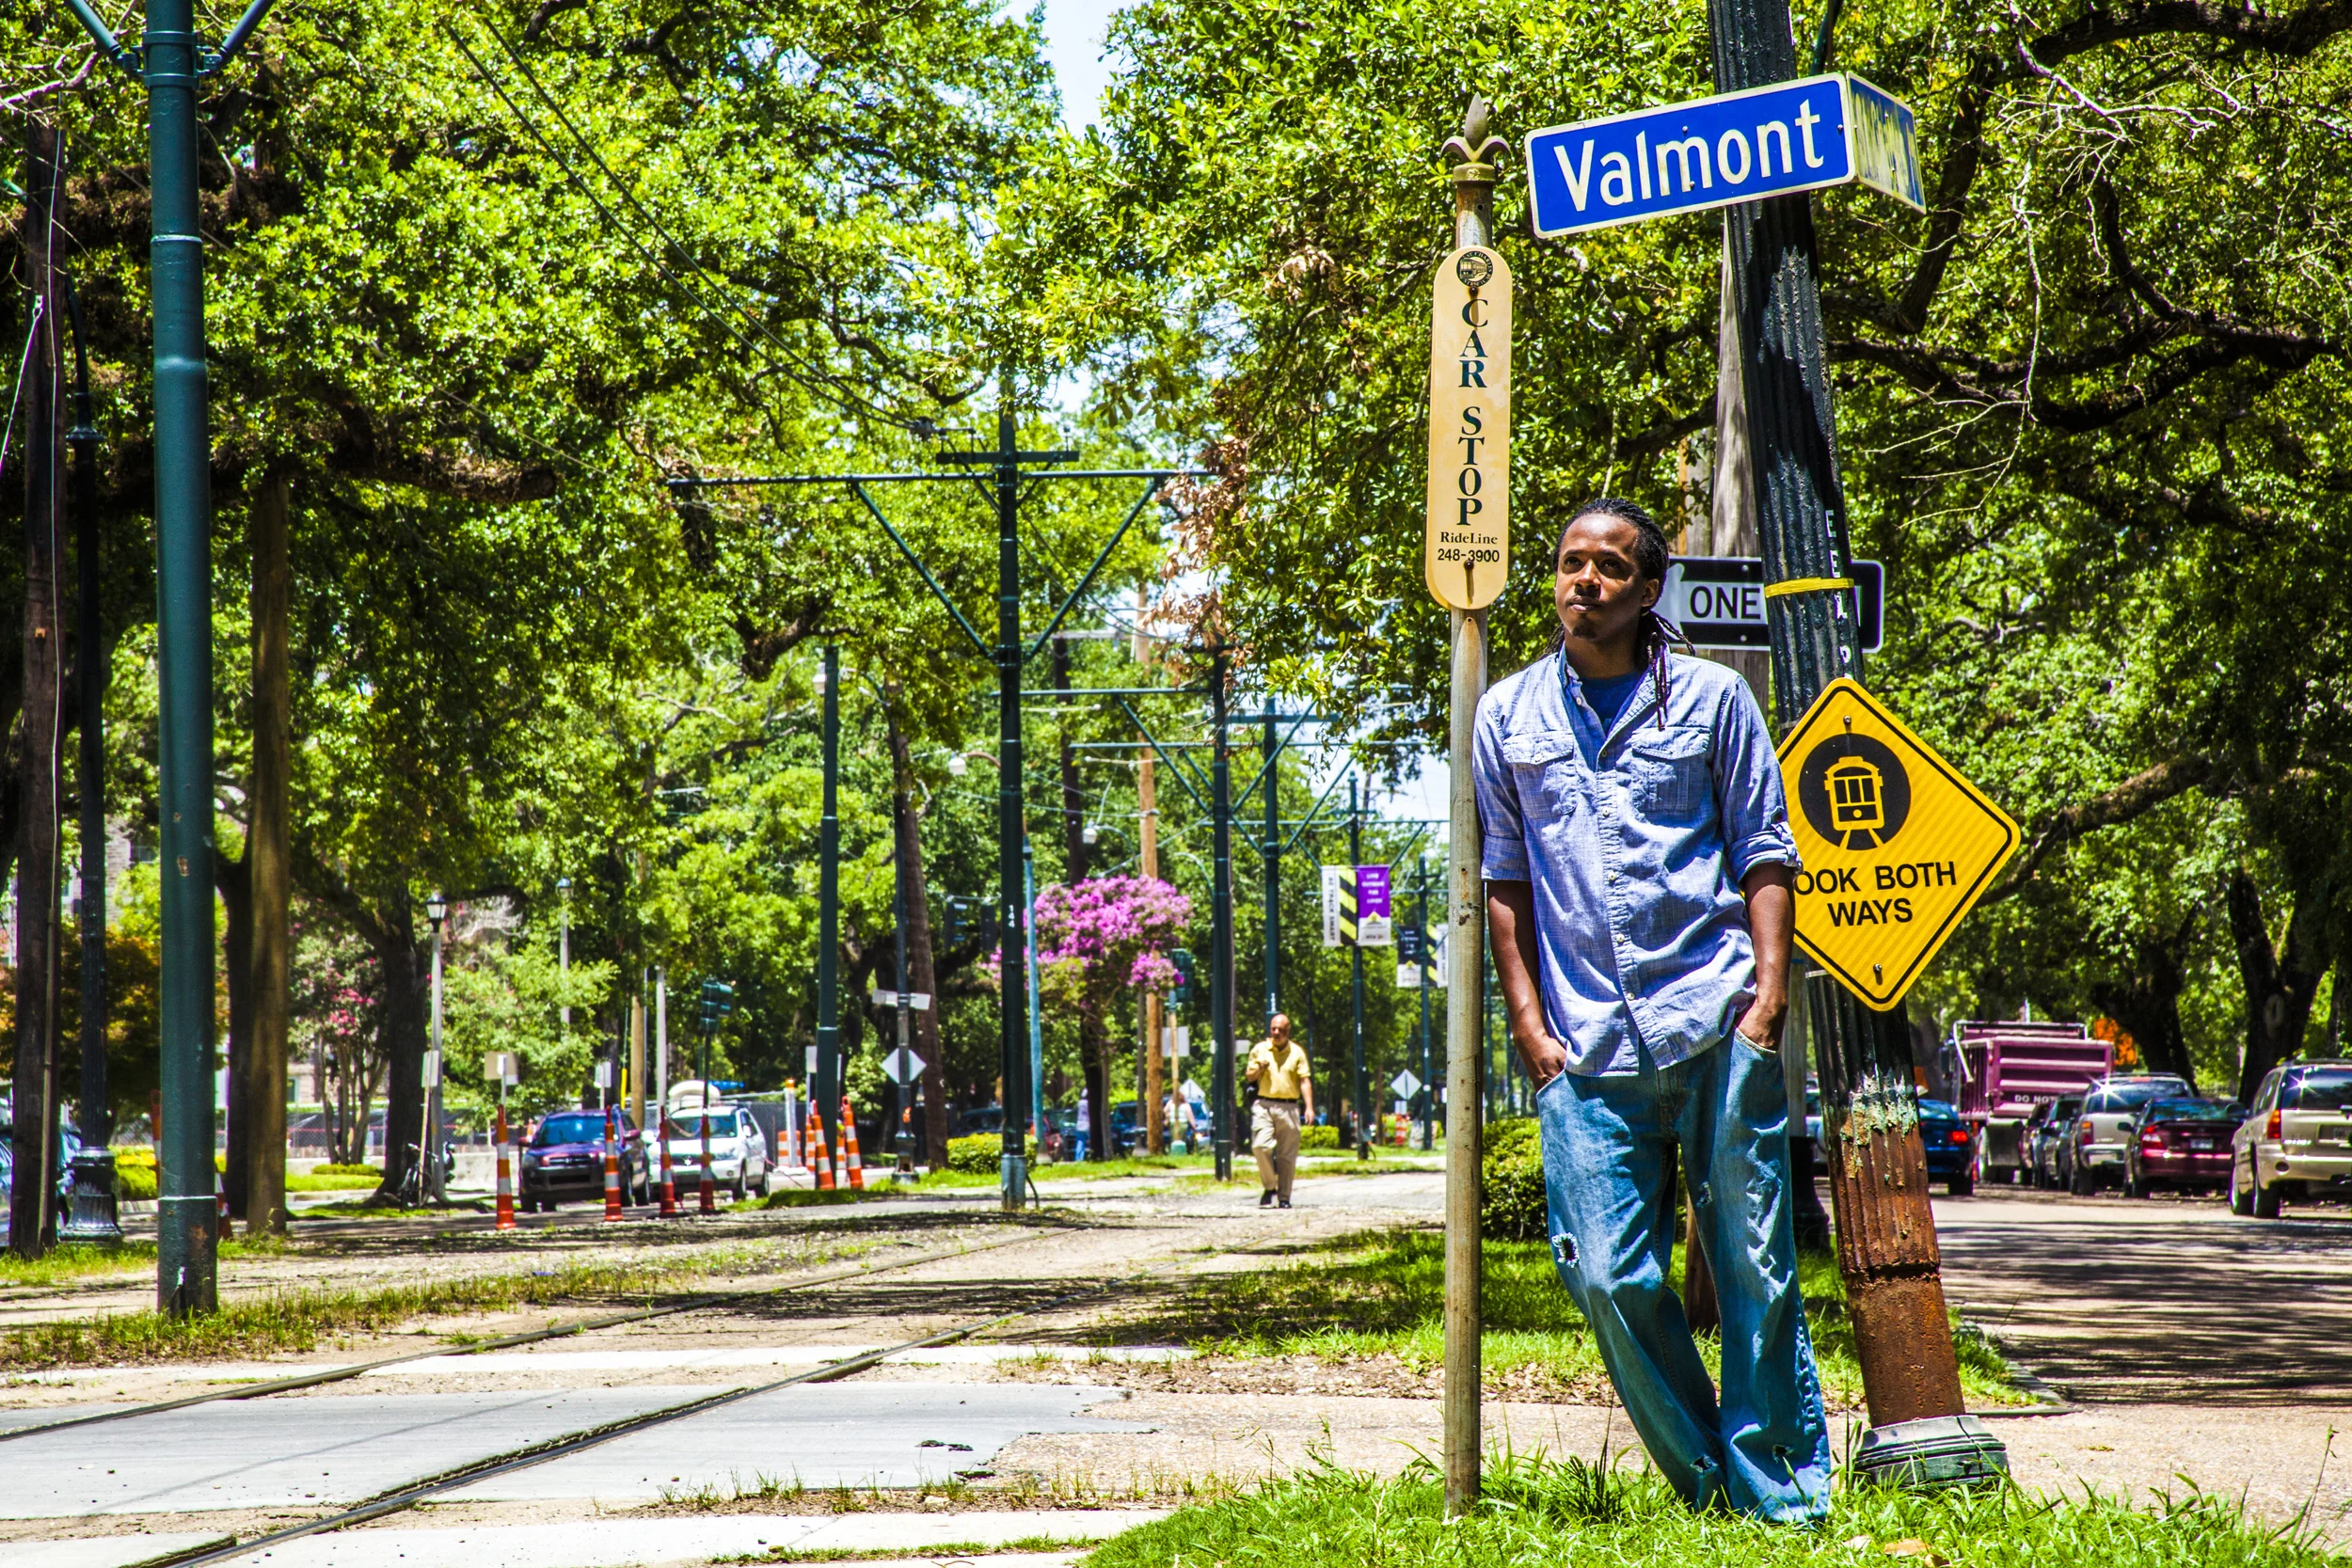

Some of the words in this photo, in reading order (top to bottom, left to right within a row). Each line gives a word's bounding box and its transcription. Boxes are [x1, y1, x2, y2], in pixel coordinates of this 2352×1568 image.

[1553, 98, 1825, 213] Valmont
[1458, 298, 1488, 388] CAR
[1456, 405, 1486, 526] STOP
[1438, 548, 1500, 562] 248-3900
[1440, 531, 1498, 545] RideLine
[1690, 585, 1761, 620] ONE
[1793, 867, 1861, 895] OOK
[1875, 861, 1957, 890] BOTH
[1827, 897, 1914, 927] WAYS
[2014, 1094, 2030, 1103] DO
